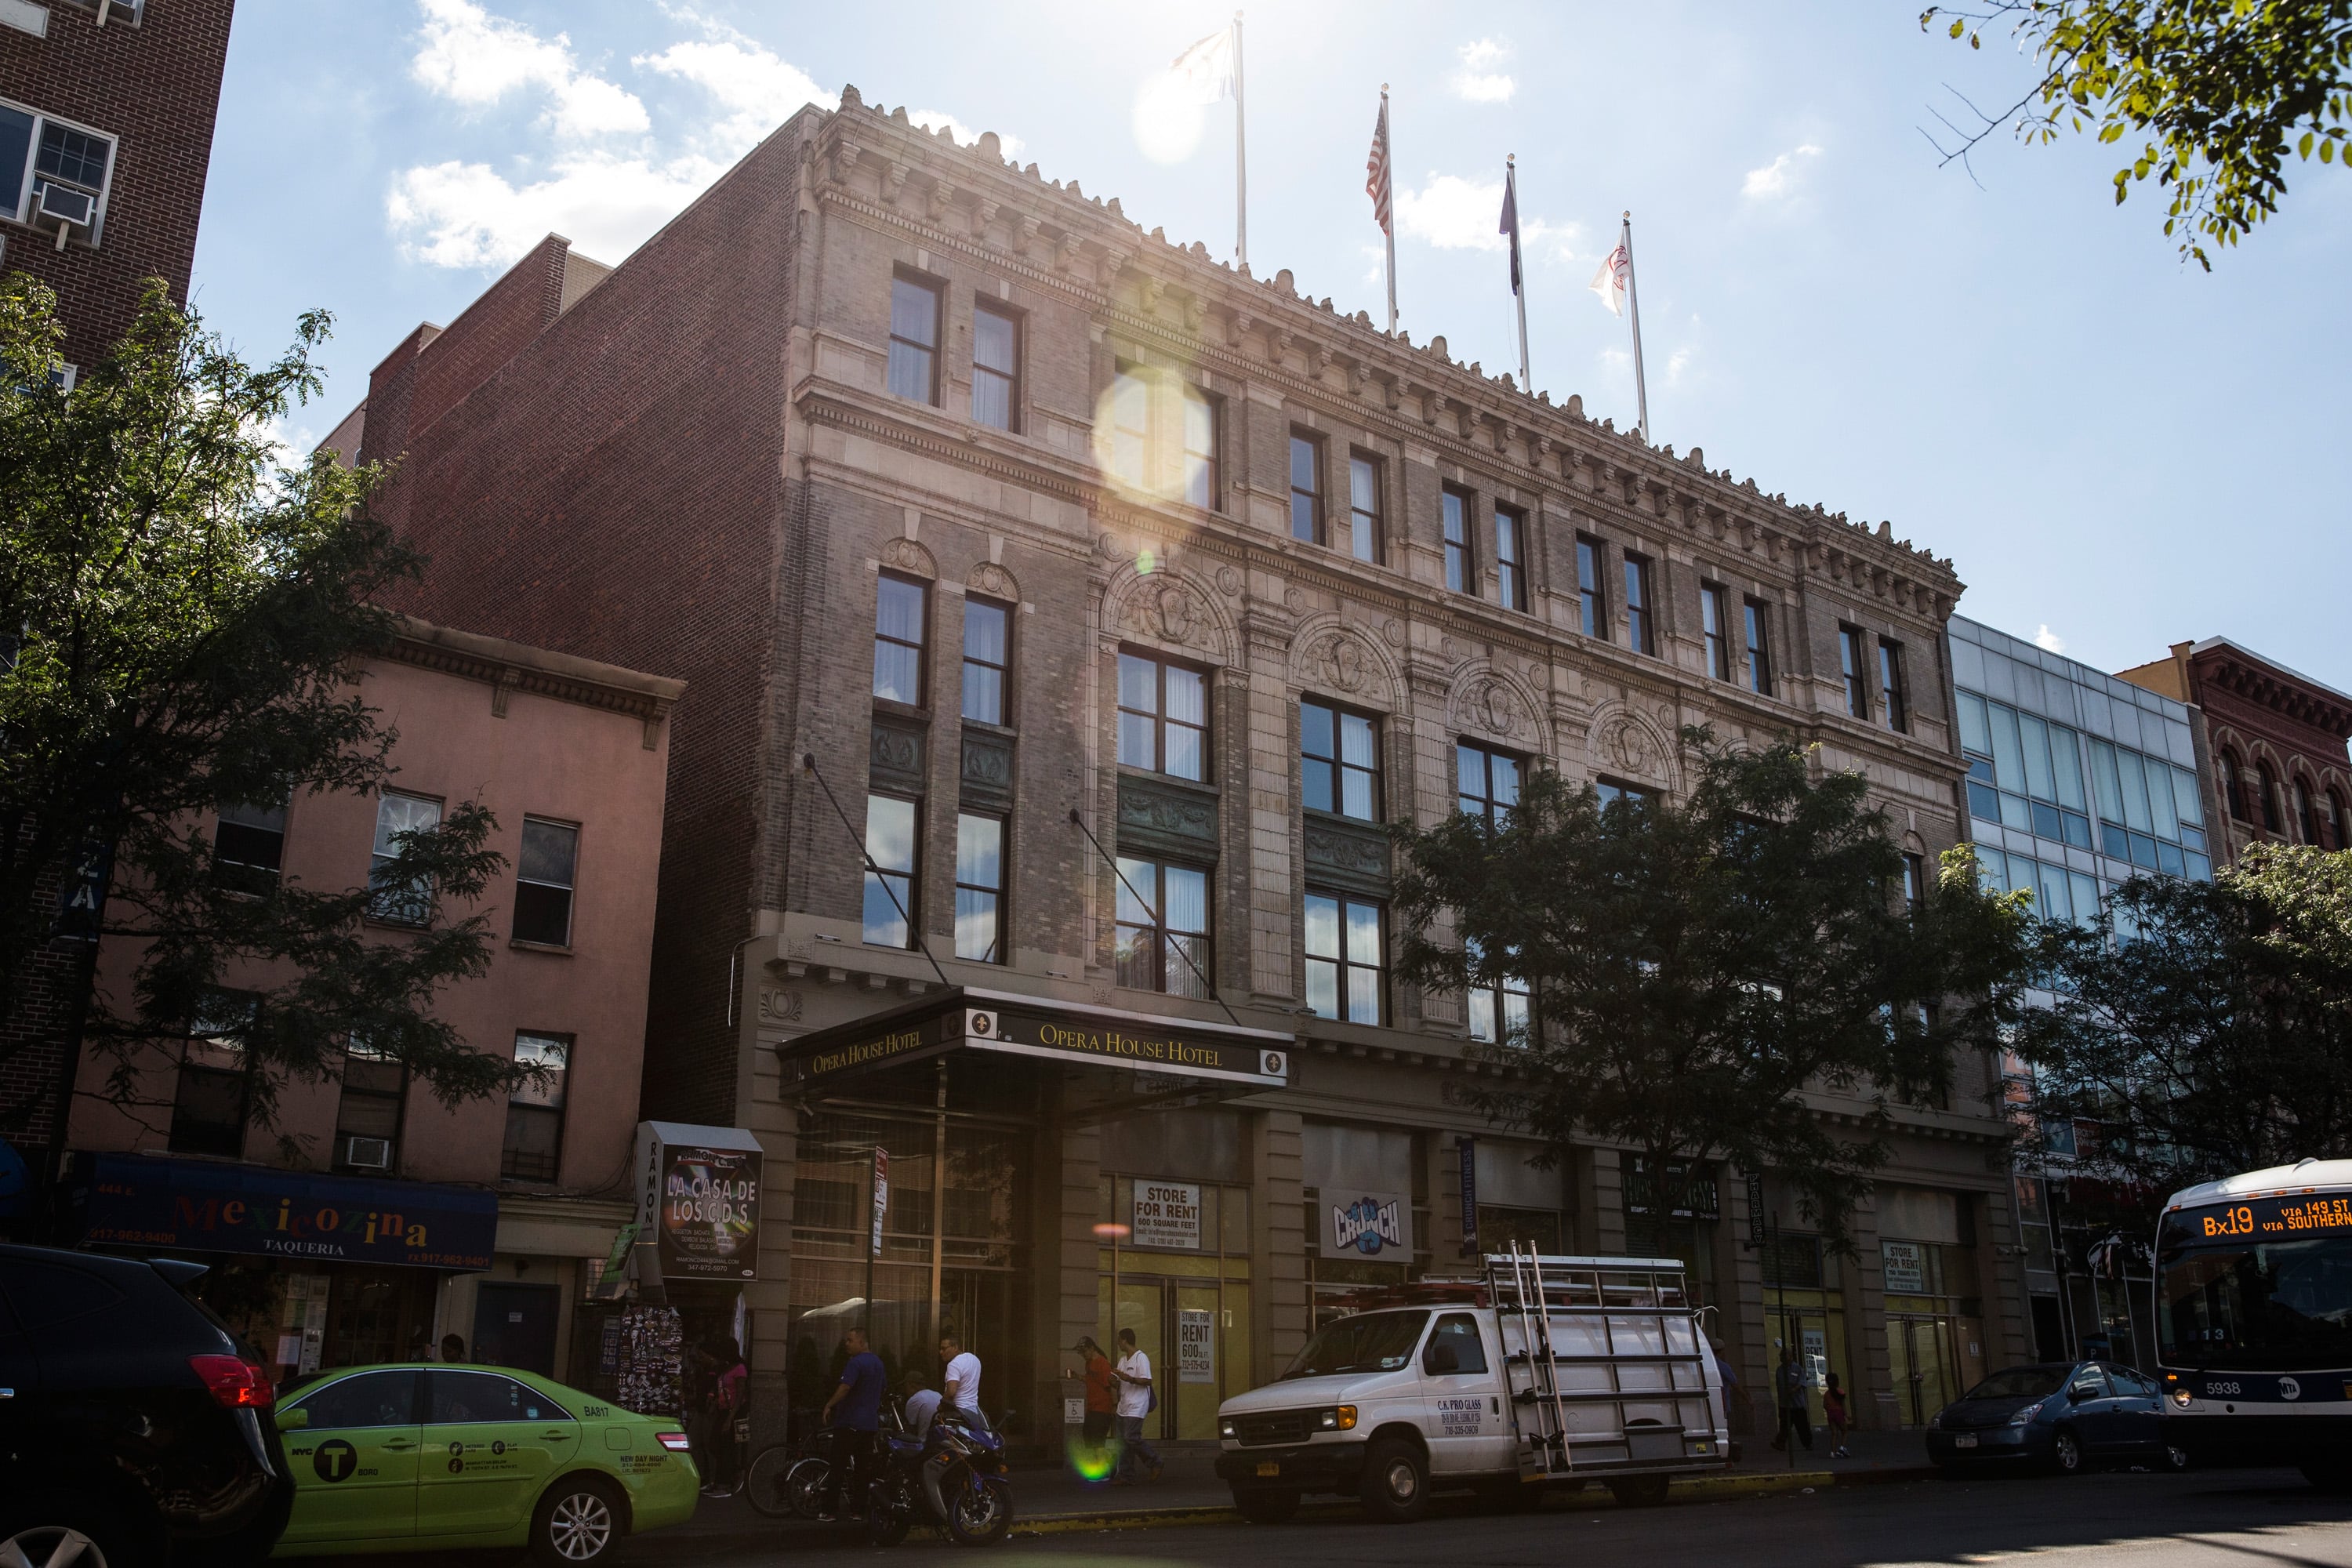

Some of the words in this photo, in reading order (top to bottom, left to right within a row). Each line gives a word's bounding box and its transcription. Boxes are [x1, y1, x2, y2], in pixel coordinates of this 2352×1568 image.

[813, 1052, 847, 1073] OPERA
[848, 1041, 885, 1065] HOUSE
[886, 1031, 922, 1054] HOTEL
[1040, 1024, 1100, 1051] OPERA
[1106, 1033, 1164, 1058] HOUSE
[1169, 1041, 1223, 1066] HOTEL
[1464, 1149, 1472, 1188] FITNESS
[645, 1142, 657, 1224] RAMON
[667, 1176, 686, 1197] LA
[691, 1178, 732, 1200] CASA
[738, 1181, 756, 1202] DE
[1148, 1187, 1186, 1203] STORE
[673, 1200, 702, 1222] LOS
[1136, 1202, 1160, 1217] FOR
[1166, 1204, 1197, 1219] RENT
[1465, 1189, 1474, 1229] CRUNCH
[1749, 1173, 1762, 1243] PHARMACY
[2281, 1207, 2302, 1218] VIA
[2306, 1200, 2328, 1215] 149
[2332, 1199, 2349, 1214] ST
[171, 1196, 427, 1247] Mexicozina
[1138, 1218, 1150, 1226] 600
[1153, 1219, 1178, 1229] SQUARE
[1334, 1200, 1400, 1248] CRUNCH
[2203, 1207, 2254, 1236] Bx19
[2263, 1221, 2284, 1232] VIA
[2287, 1212, 2352, 1230] SOUTHERN
[263, 1239, 345, 1255] TAQUERIA
[1890, 1247, 1912, 1258] STORE
[1886, 1258, 1899, 1269] FOR
[1901, 1258, 1918, 1269] RENT
[1181, 1312, 1197, 1322] STORE
[1200, 1313, 1210, 1323] FOR
[1181, 1324, 1210, 1342] RENT
[1182, 1344, 1198, 1357] 600
[2206, 1382, 2241, 1395] 5938
[584, 1406, 608, 1417] BA817
[1437, 1400, 1449, 1410] C.K.
[1450, 1399, 1464, 1410] PRO
[1465, 1399, 1482, 1410] GLASS
[1445, 1425, 1479, 1436] 718-335-0909
[324, 1446, 349, 1477] T
[358, 1468, 379, 1476] BORO
